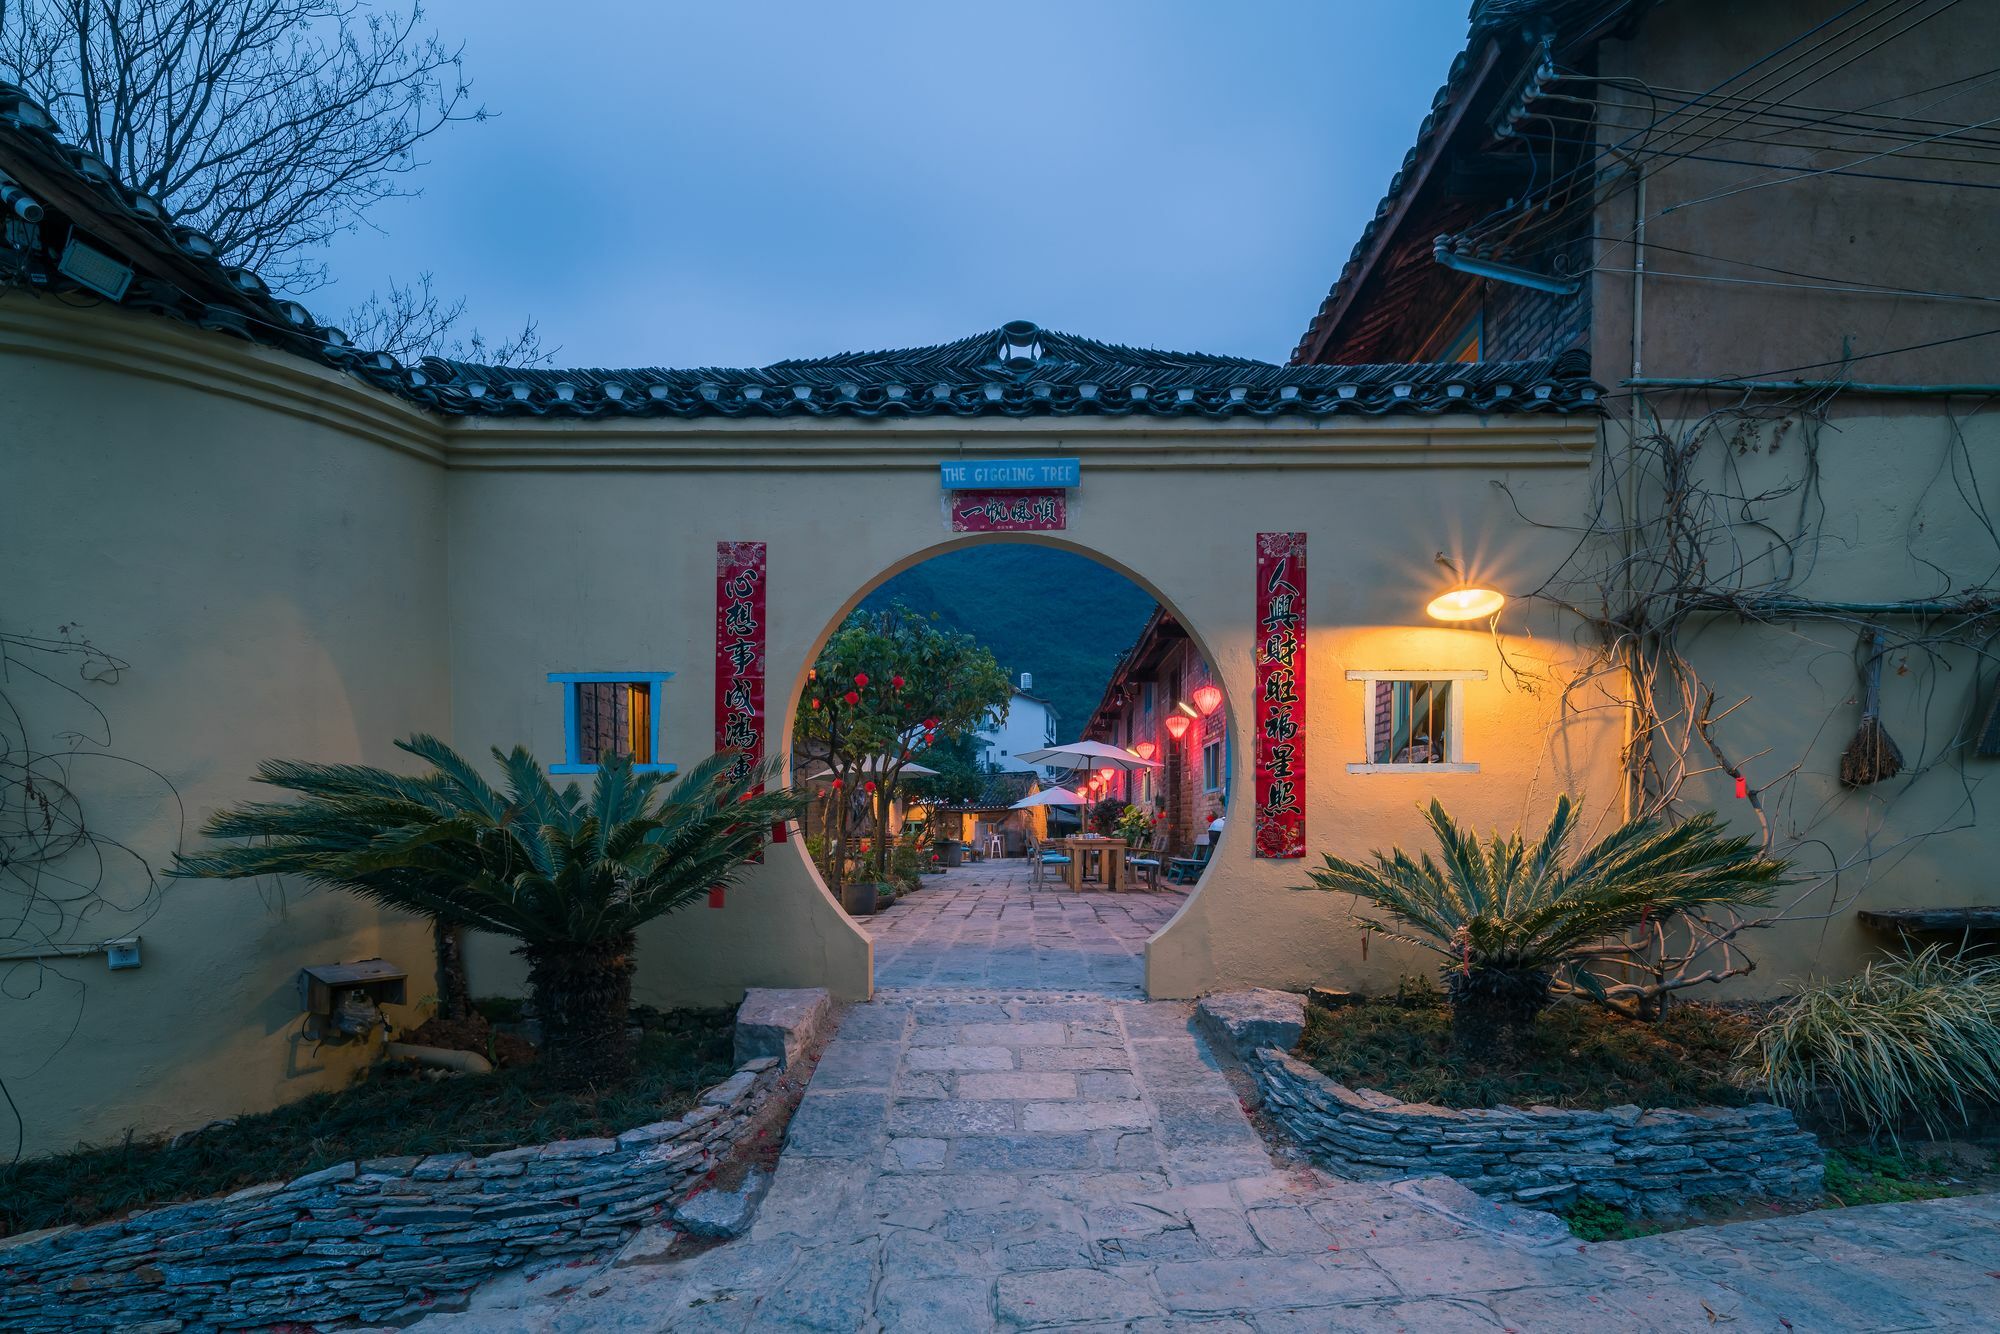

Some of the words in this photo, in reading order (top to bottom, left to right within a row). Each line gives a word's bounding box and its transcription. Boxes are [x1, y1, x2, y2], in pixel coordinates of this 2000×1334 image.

[942, 467, 966, 482] THE
[974, 467, 1035, 482] GIGGLING
[1041, 465, 1073, 482] TREE
[1262, 558, 1300, 818] 人興財旺福星照
